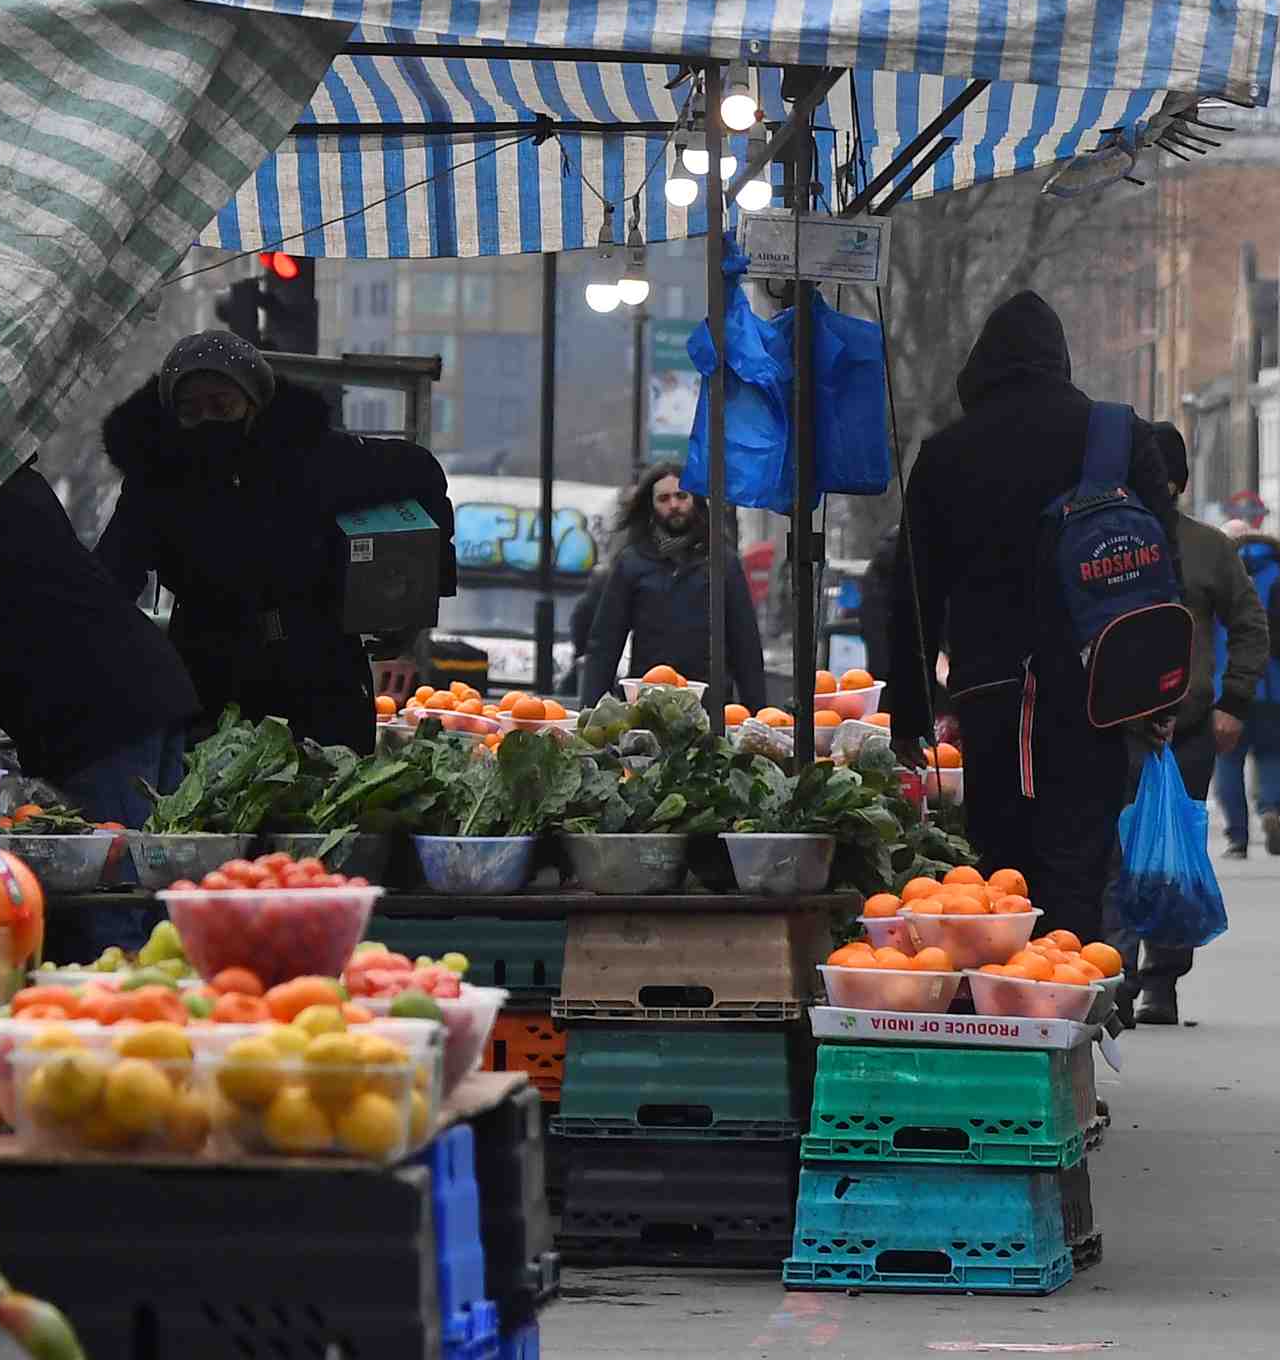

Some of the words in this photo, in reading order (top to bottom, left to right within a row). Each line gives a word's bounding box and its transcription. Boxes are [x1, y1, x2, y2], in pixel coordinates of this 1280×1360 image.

[1079, 543, 1161, 582] REDSKINS
[870, 1017, 915, 1032] INDIA
[919, 1019, 941, 1034] OF
[944, 1022, 1020, 1038] PRODUCE
